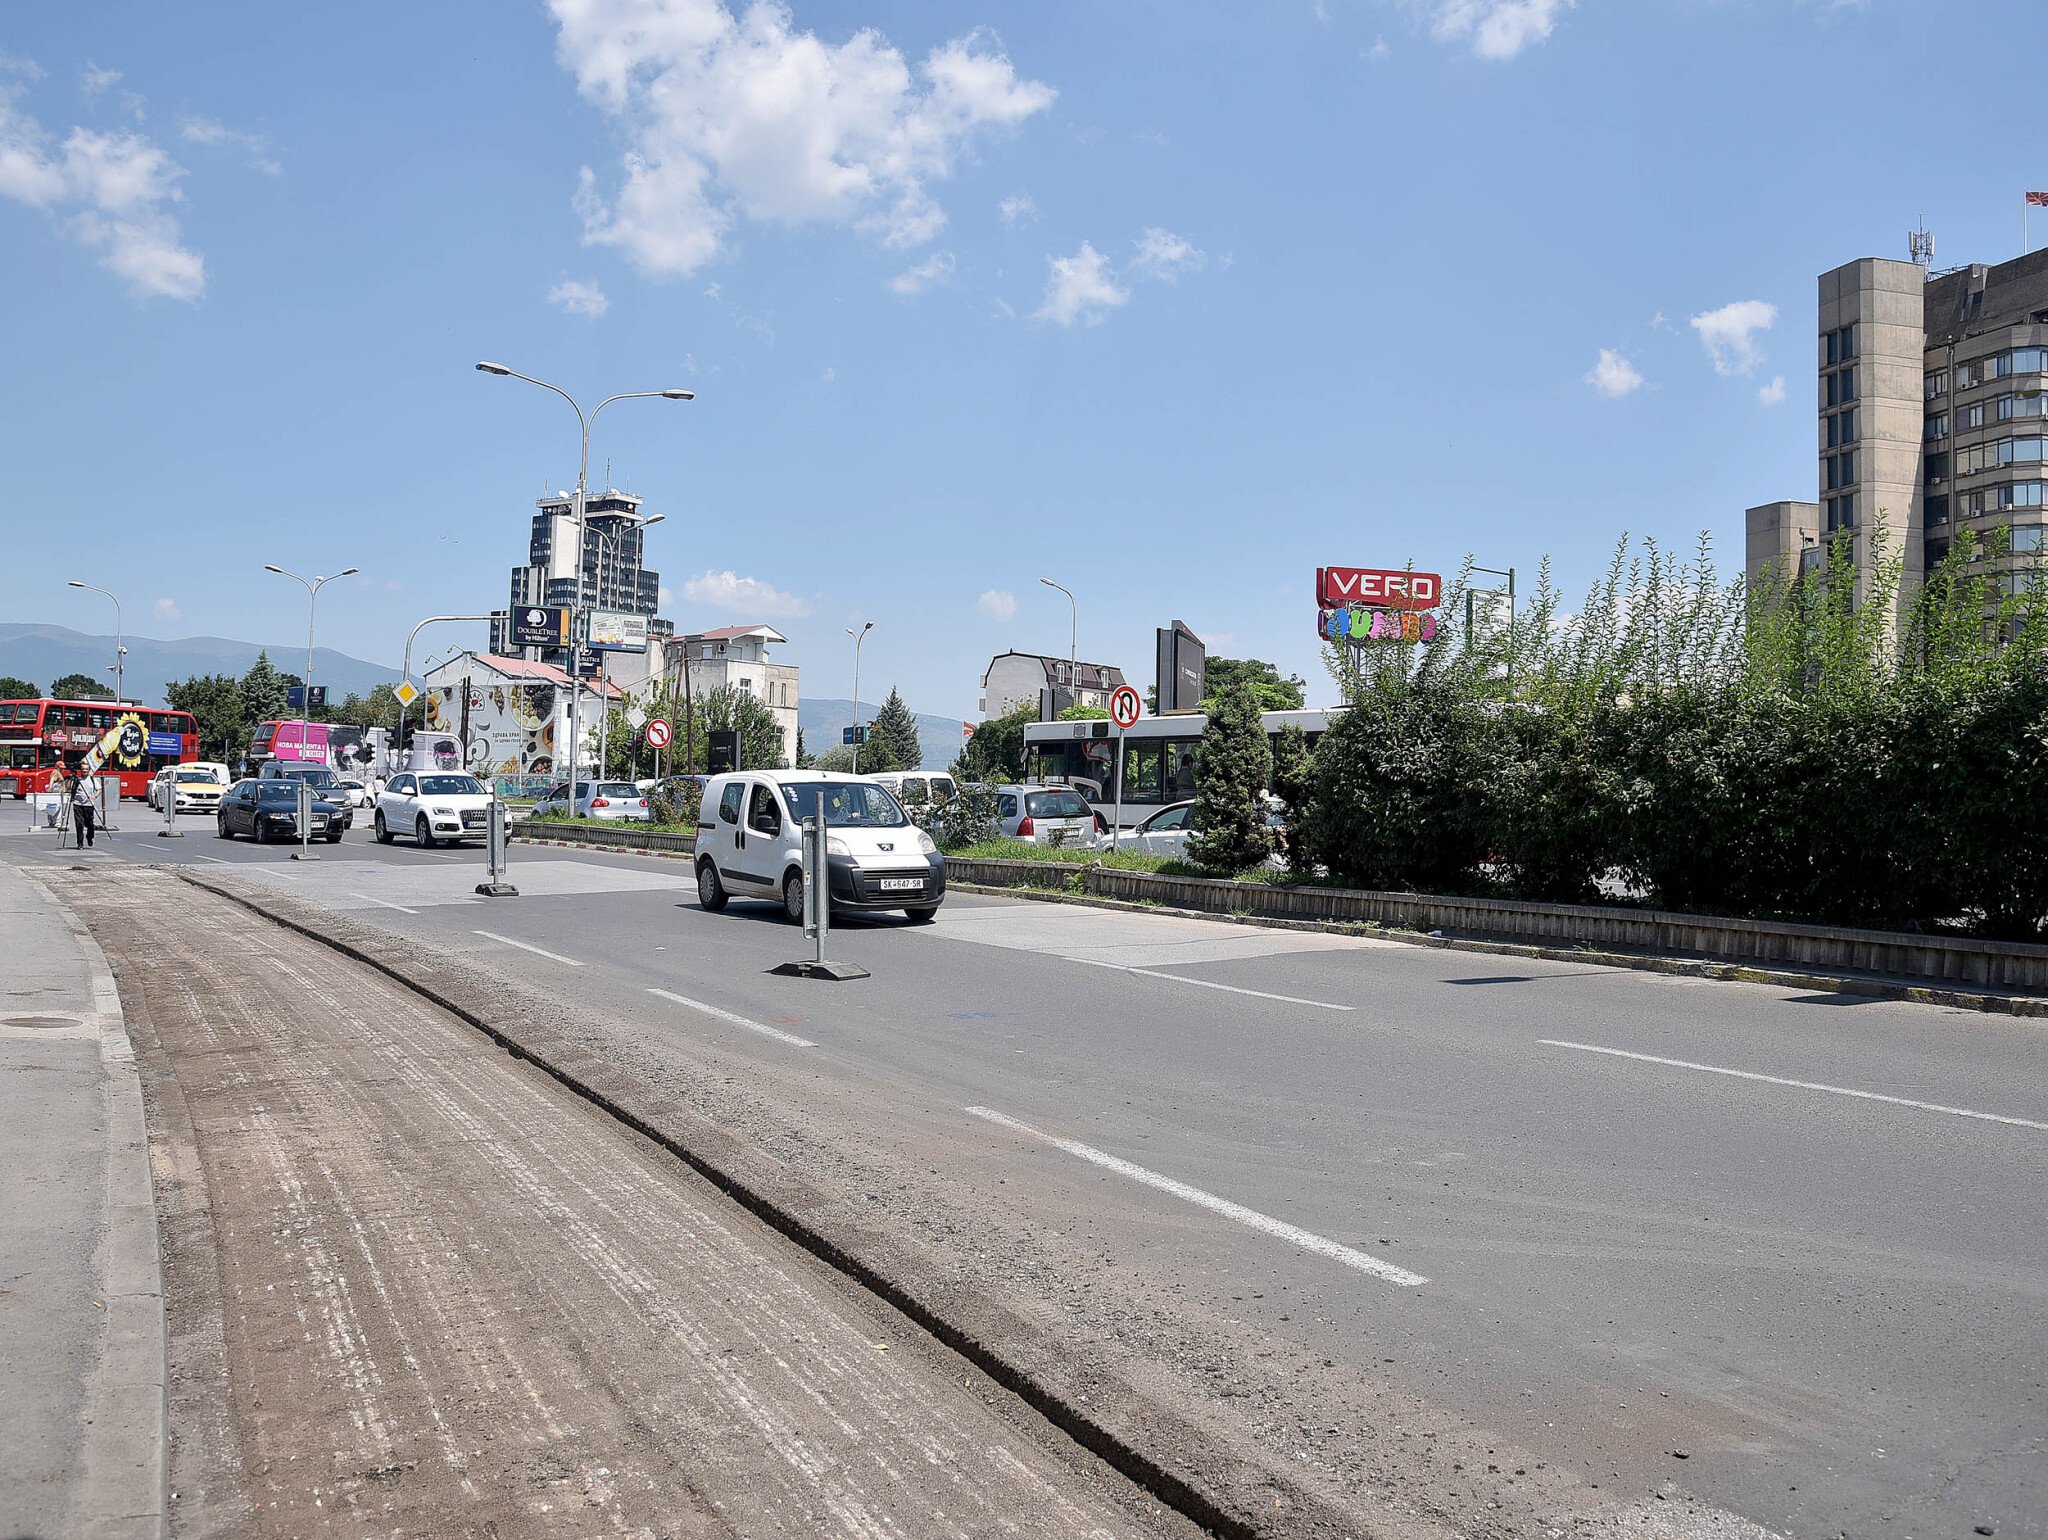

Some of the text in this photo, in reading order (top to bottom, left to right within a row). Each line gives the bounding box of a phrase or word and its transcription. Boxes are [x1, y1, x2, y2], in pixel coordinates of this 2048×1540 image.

[1332, 571, 1434, 600] VERO
[294, 742, 322, 750] МАЕНТА
[883, 879, 921, 888] SK 647-SR
